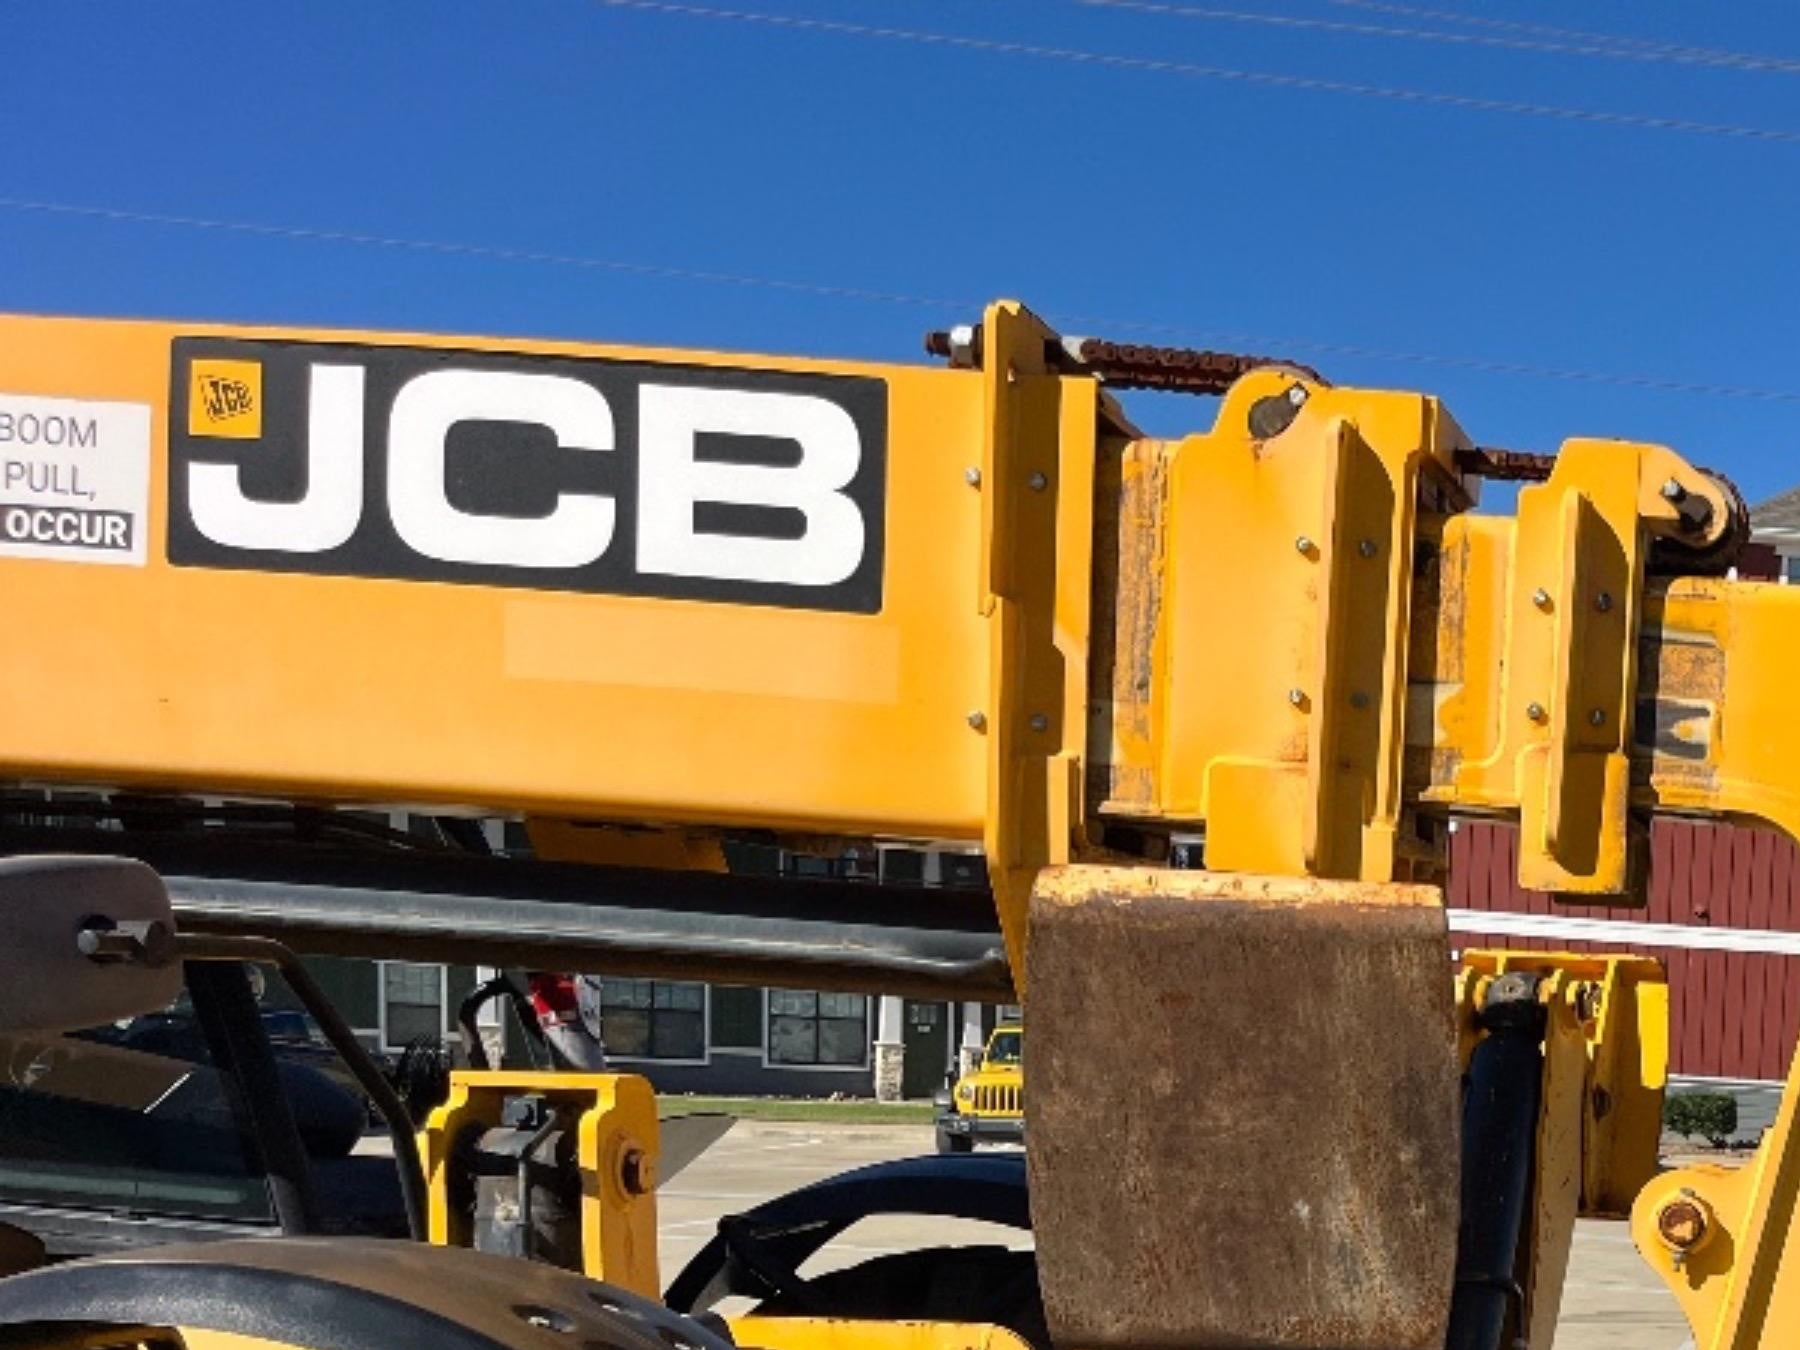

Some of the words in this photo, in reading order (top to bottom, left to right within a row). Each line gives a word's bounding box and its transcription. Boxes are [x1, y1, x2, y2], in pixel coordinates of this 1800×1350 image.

[0, 412, 98, 448] BOOM
[4, 460, 97, 502] PULL,
[187, 362, 865, 586] JCB
[4, 507, 128, 548] OCCUR
